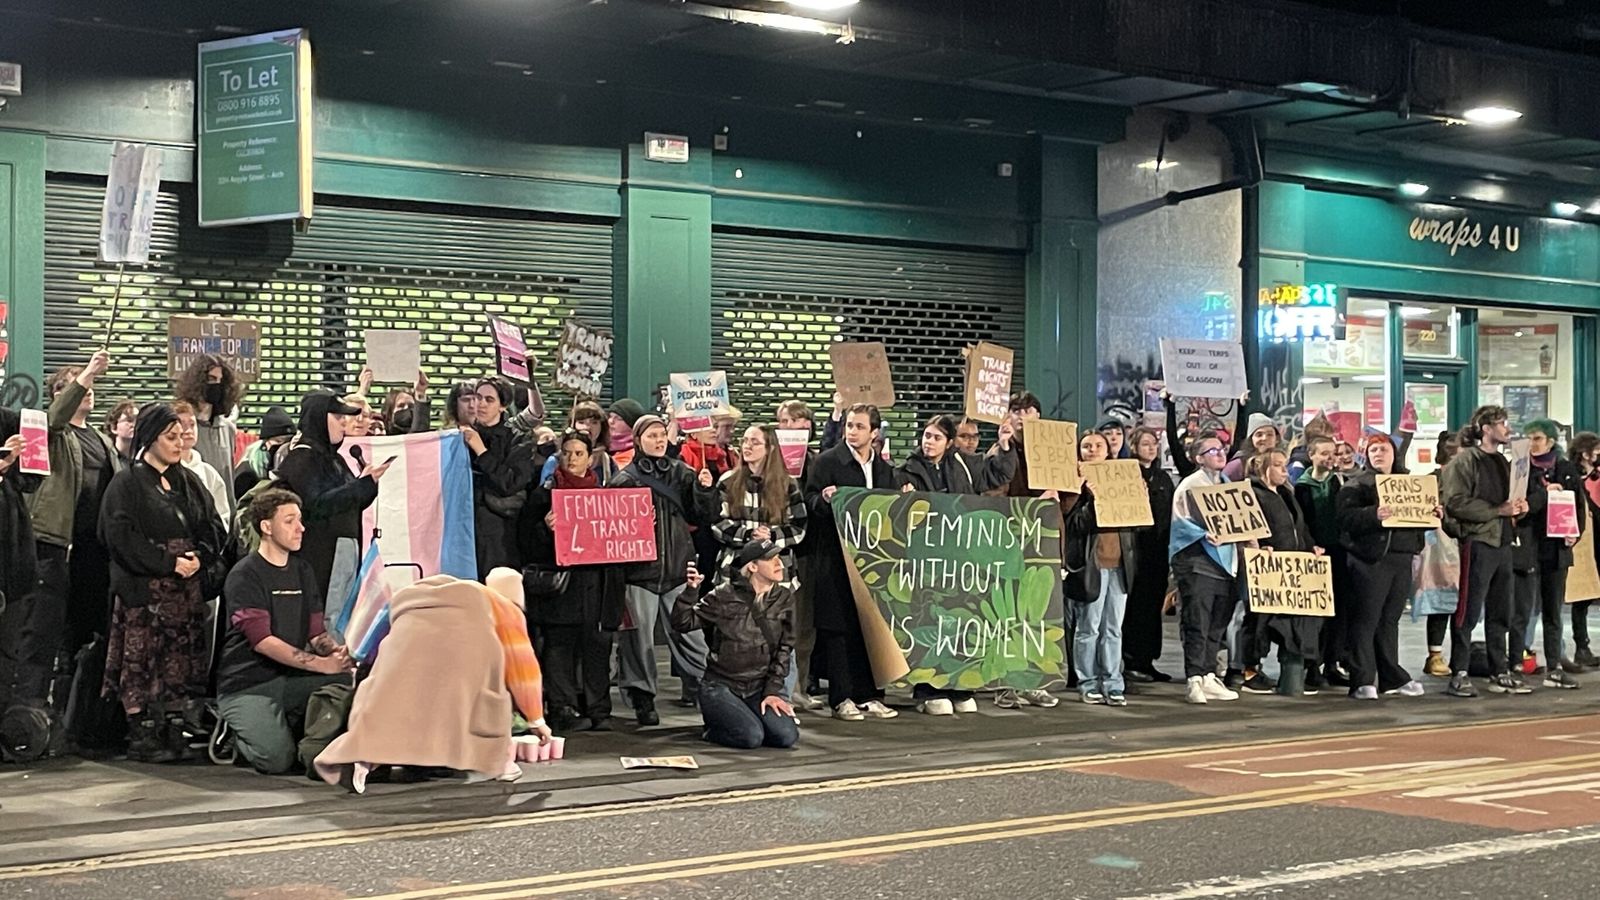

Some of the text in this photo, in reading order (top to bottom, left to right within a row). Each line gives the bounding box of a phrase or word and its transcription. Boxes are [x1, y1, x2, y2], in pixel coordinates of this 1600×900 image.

[219, 65, 278, 92] To Let
[241, 97, 256, 109] 916
[1409, 217, 1519, 256] wraps 4 U
[200, 322, 236, 337] LET
[1420, 330, 1436, 341] 220
[982, 356, 1012, 373] TRANS
[1186, 361, 1201, 369] OUT
[688, 378, 712, 388] TRANS
[978, 369, 1007, 388] RIGHTS
[1186, 375, 1223, 384] GLASGOW
[677, 388, 725, 400] PEOPLE MAKE
[685, 400, 719, 411] GLASGOW
[977, 401, 1006, 419] RIGHTS
[1027, 420, 1074, 445] TRANS
[1379, 477, 1422, 493] TRANS
[563, 494, 650, 521] FEMINISTS
[1202, 488, 1254, 512] NO TO
[1383, 494, 1422, 504] RIGHTS
[571, 519, 637, 553] 4 TRANS
[843, 509, 1042, 552] NO FEMINISM
[606, 540, 652, 559] RIGHTS
[1249, 553, 1328, 575] TRANS RIGHTS
[899, 558, 1006, 594] WITHOUT
[1280, 572, 1301, 588] ARE
[1251, 587, 1283, 607] HUMAN
[936, 614, 1045, 658] WOMEN
